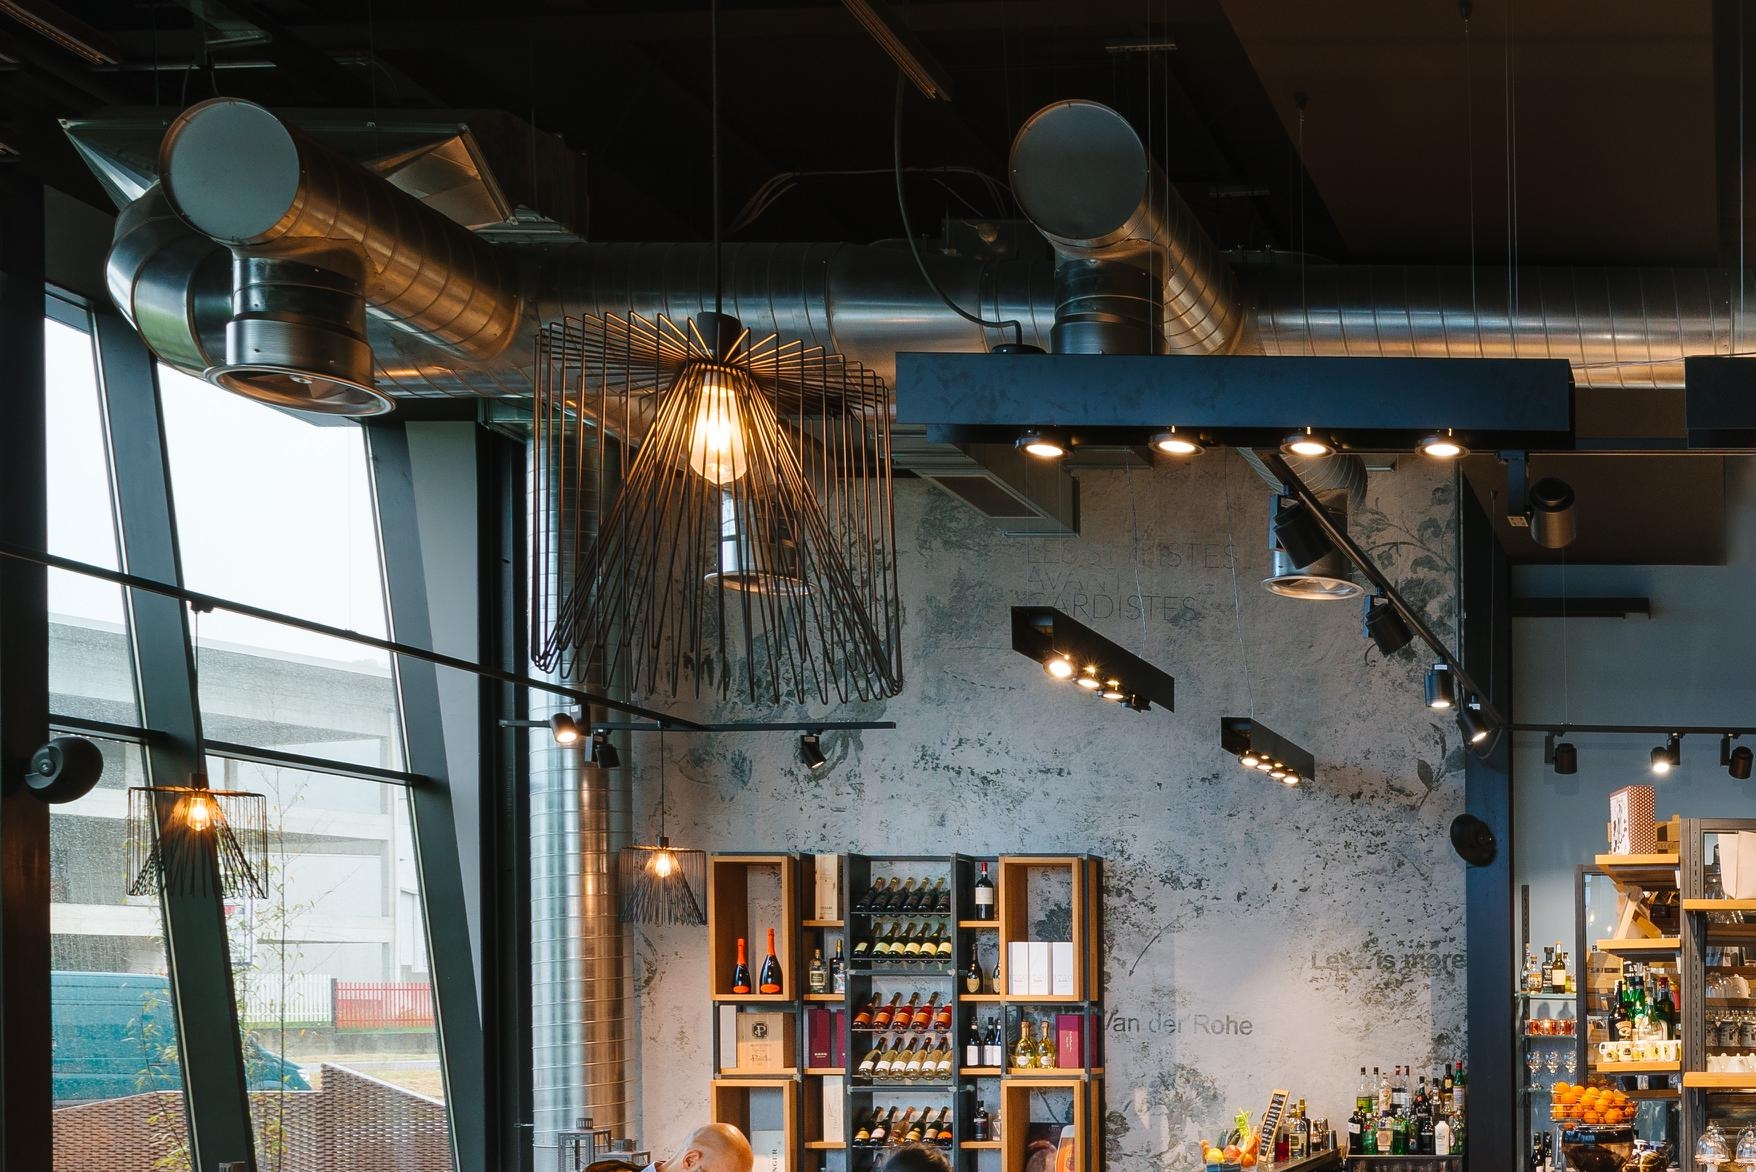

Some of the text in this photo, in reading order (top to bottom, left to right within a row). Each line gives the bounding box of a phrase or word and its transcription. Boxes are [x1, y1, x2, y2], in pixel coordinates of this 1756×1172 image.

[1376, 950, 1396, 970] is
[1148, 1014, 1183, 1034] der
[1193, 1014, 1253, 1035] Rohe
